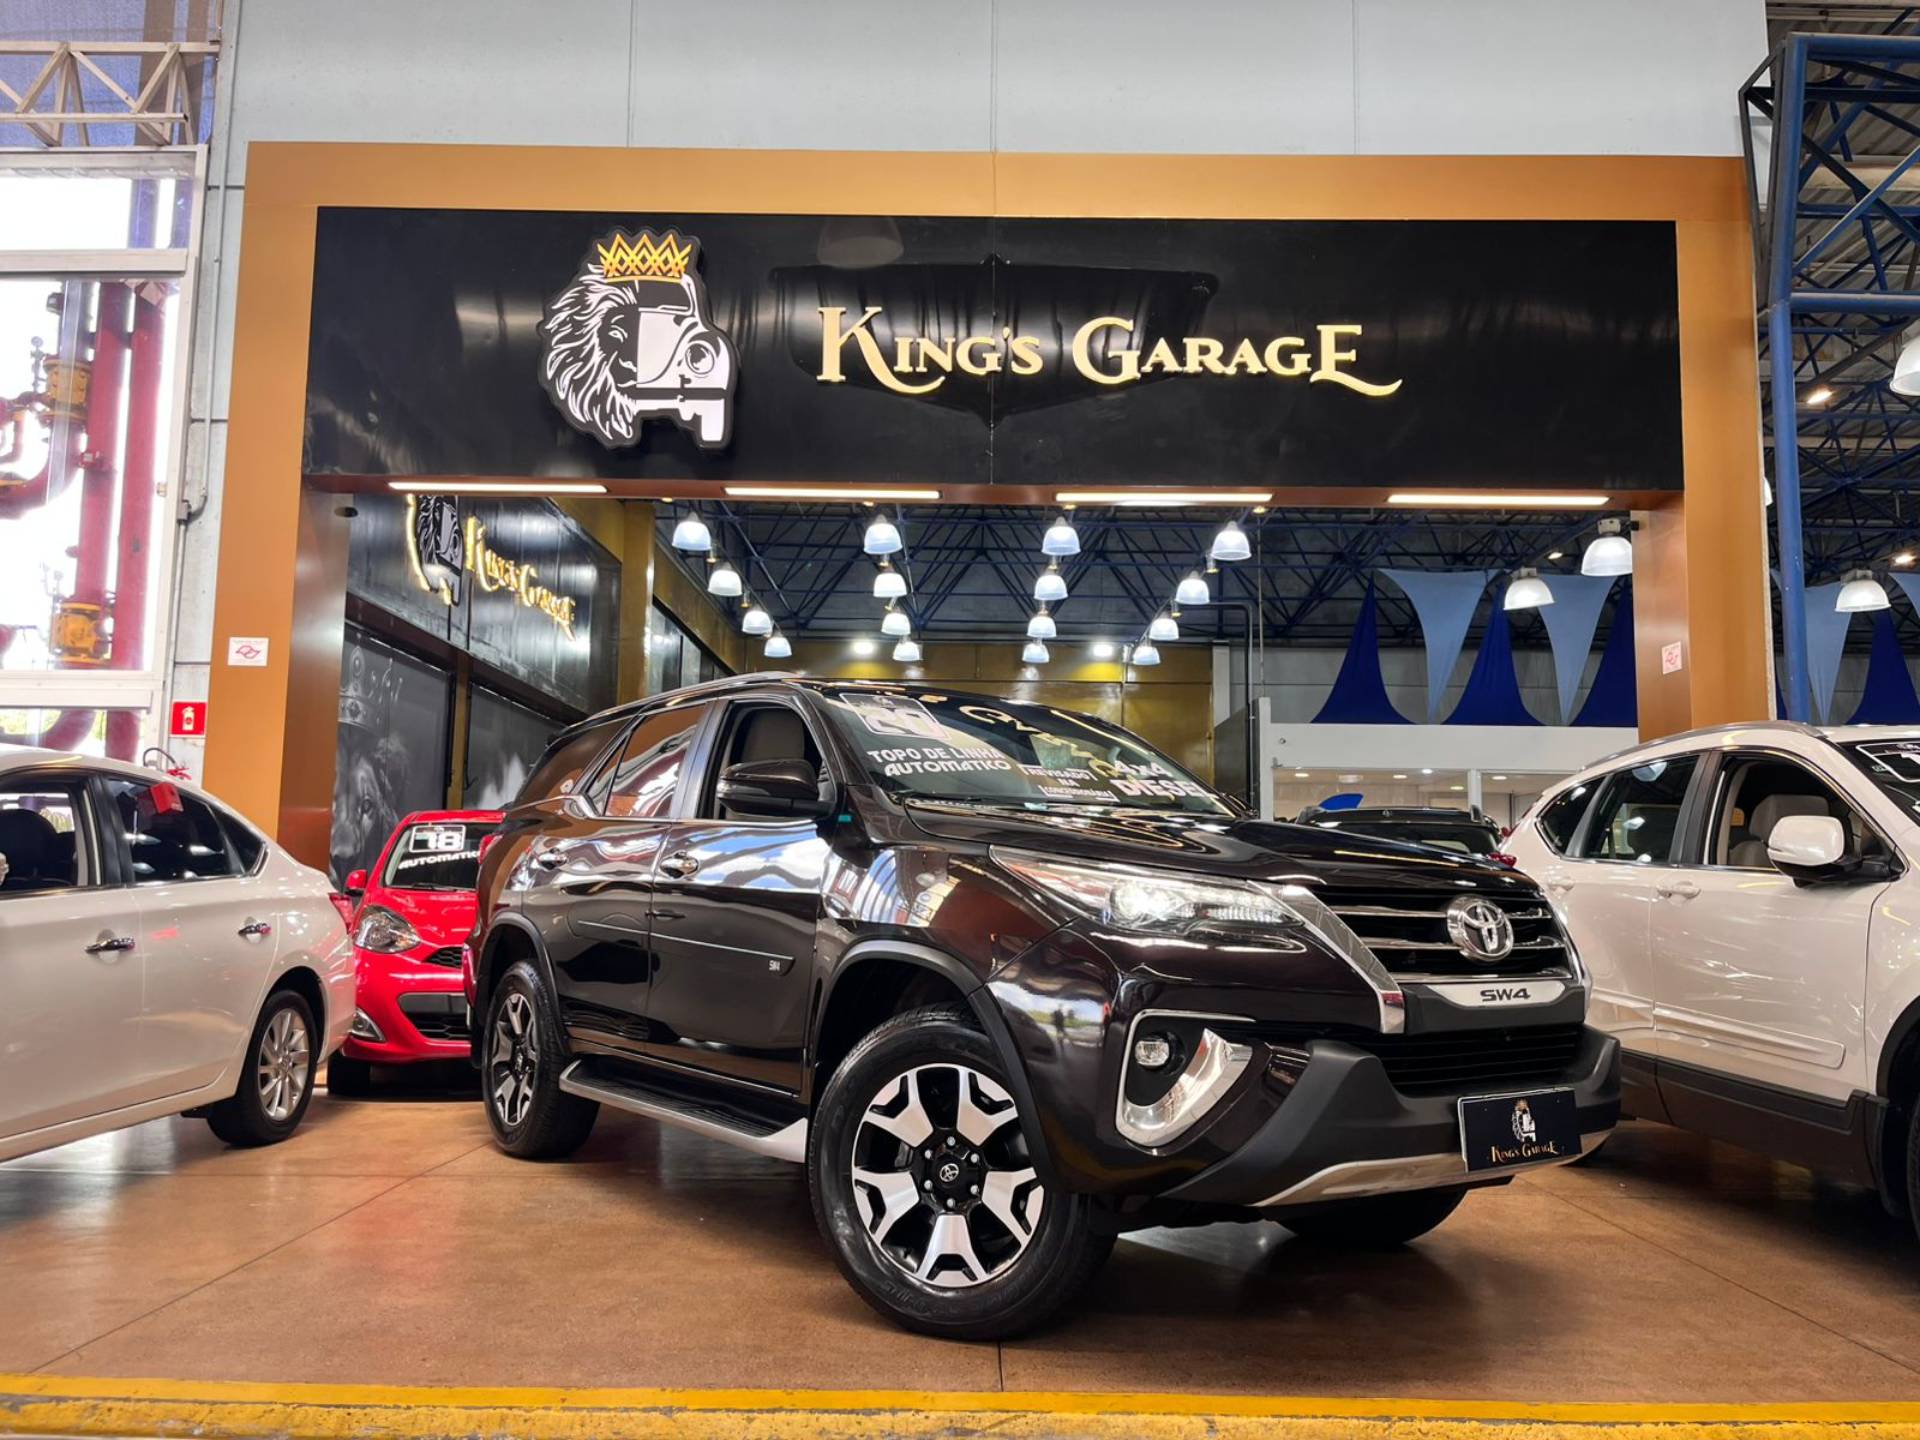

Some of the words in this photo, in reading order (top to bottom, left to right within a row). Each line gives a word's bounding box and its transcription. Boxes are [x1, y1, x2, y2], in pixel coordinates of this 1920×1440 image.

[818, 306, 1044, 394] KING'S
[1072, 316, 1402, 397] GARAGE
[867, 748, 921, 763] TOPO
[922, 747, 949, 759] DE
[950, 747, 1005, 760] LINHA
[1109, 779, 1220, 799] DIESEL
[1480, 988, 1531, 1002] SW4
